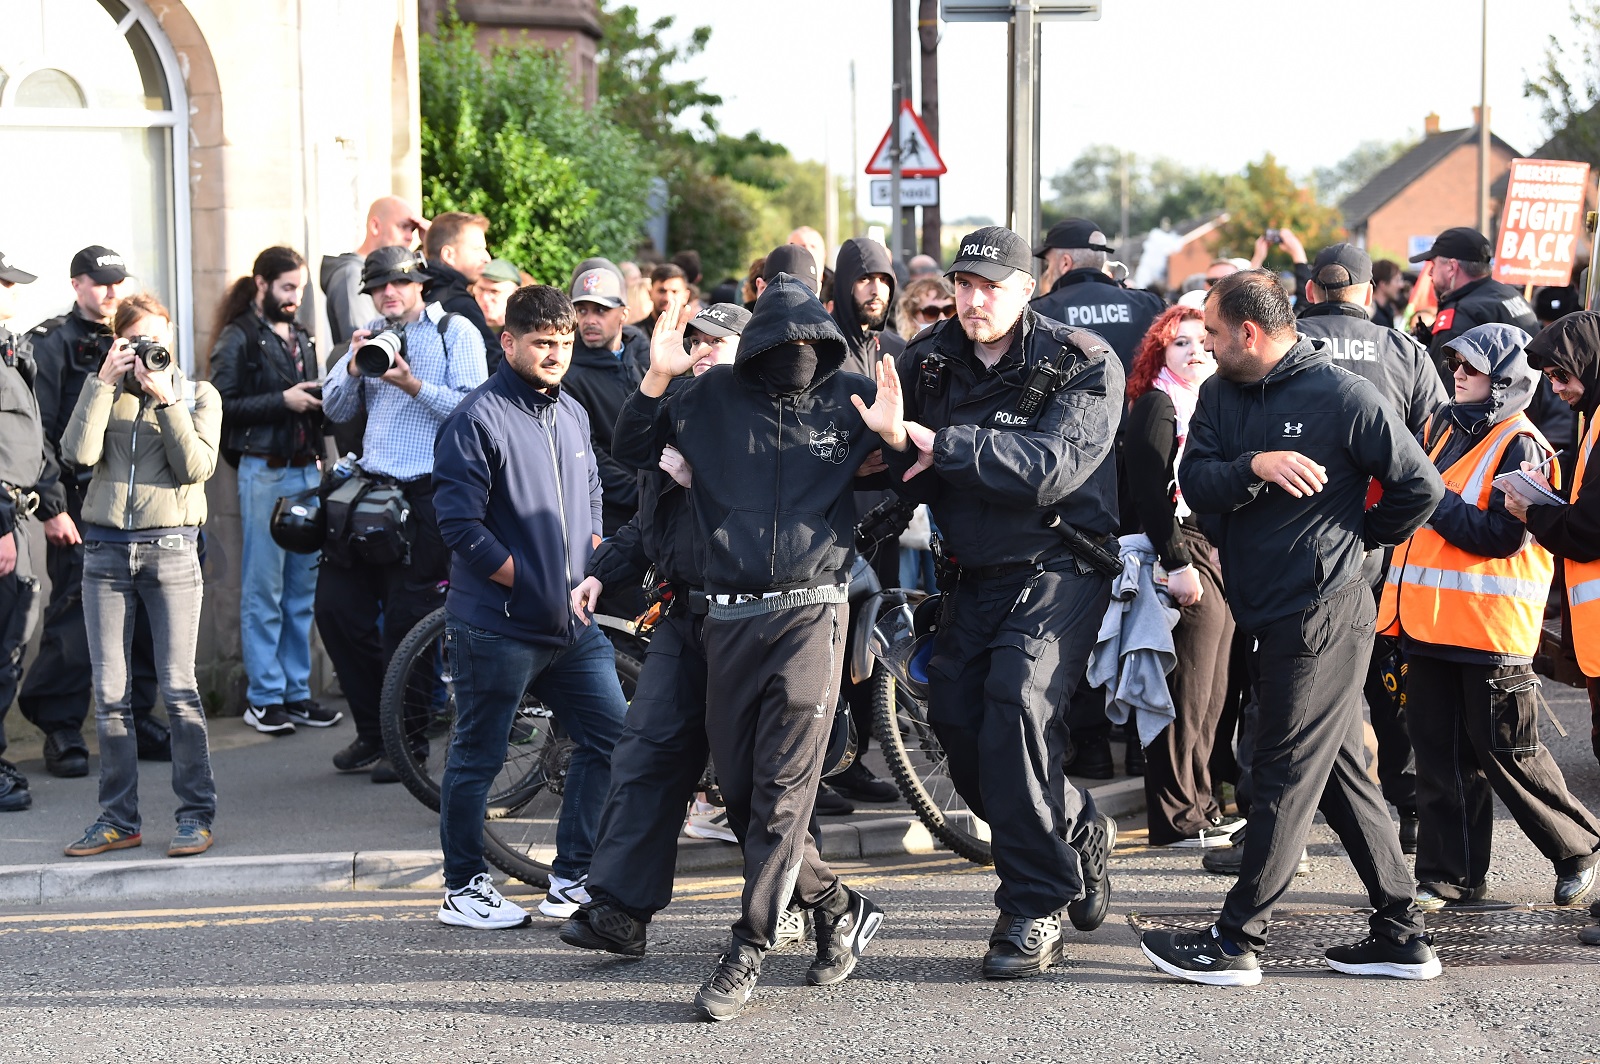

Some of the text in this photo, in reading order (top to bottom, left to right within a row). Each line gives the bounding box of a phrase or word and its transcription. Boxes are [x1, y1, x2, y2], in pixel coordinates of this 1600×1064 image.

[1506, 200, 1580, 232] FIGHT
[961, 243, 1001, 260] POLICE
[1500, 231, 1575, 263] BACK
[1067, 303, 1130, 326] POLICE
[994, 410, 1030, 425] POLICE
